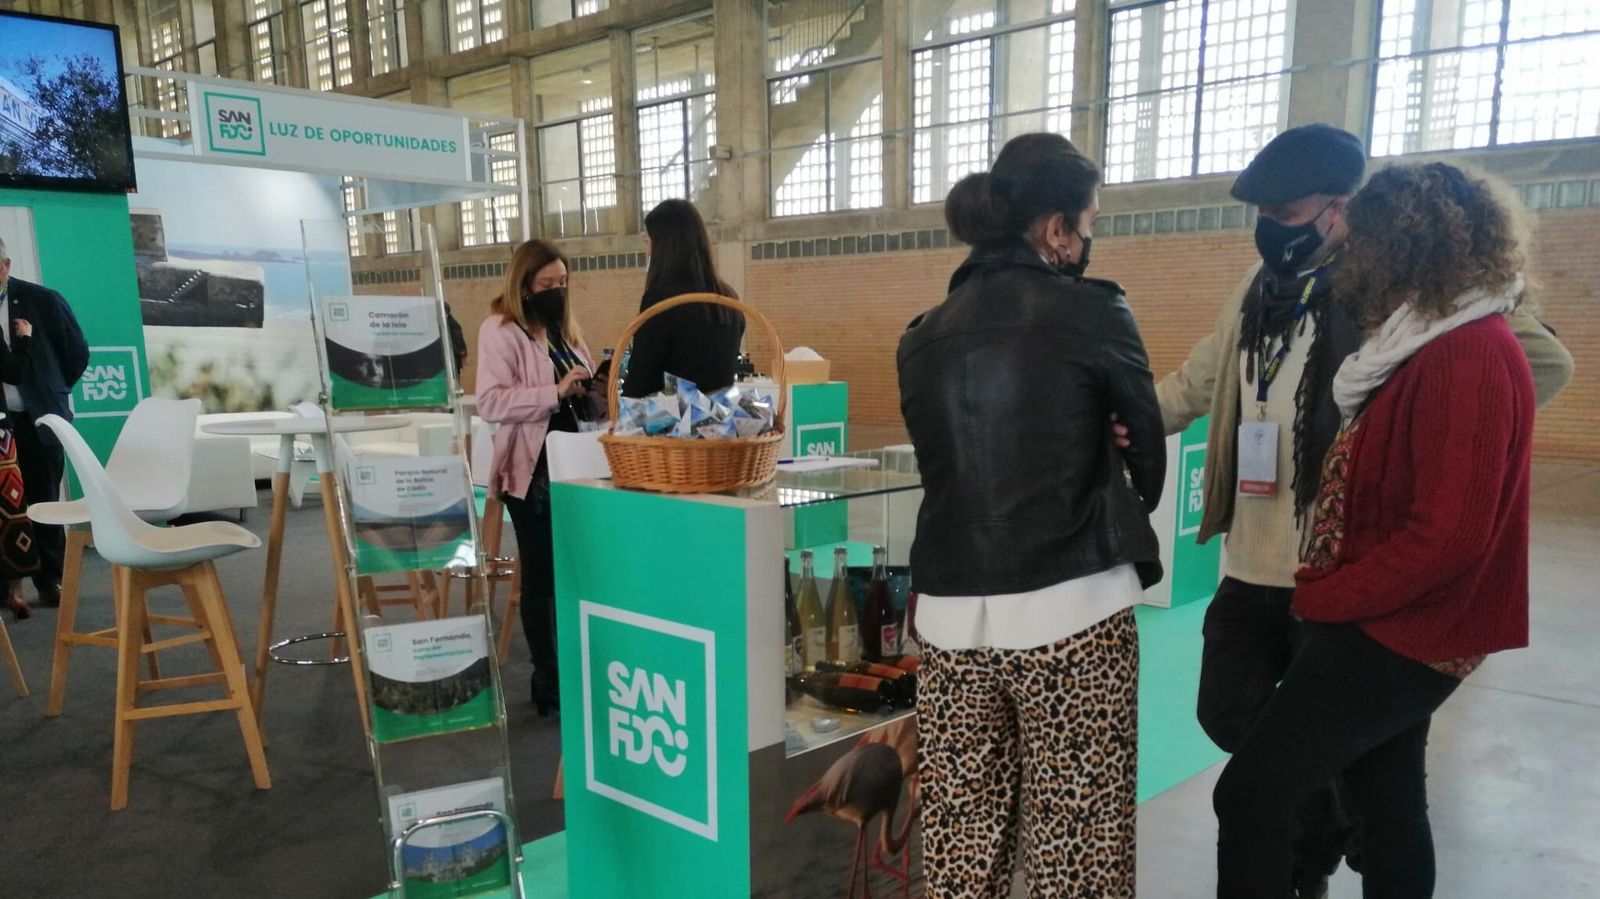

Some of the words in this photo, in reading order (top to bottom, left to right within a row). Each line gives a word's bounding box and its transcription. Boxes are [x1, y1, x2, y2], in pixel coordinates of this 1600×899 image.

[218, 108, 252, 125] SAN
[269, 121, 299, 138] LUZ
[304, 125, 324, 141] DE
[330, 128, 457, 154] OPORTUNIDADES
[81, 365, 126, 382] SAN
[806, 441, 835, 456] SAN
[607, 660, 686, 726] SAN
